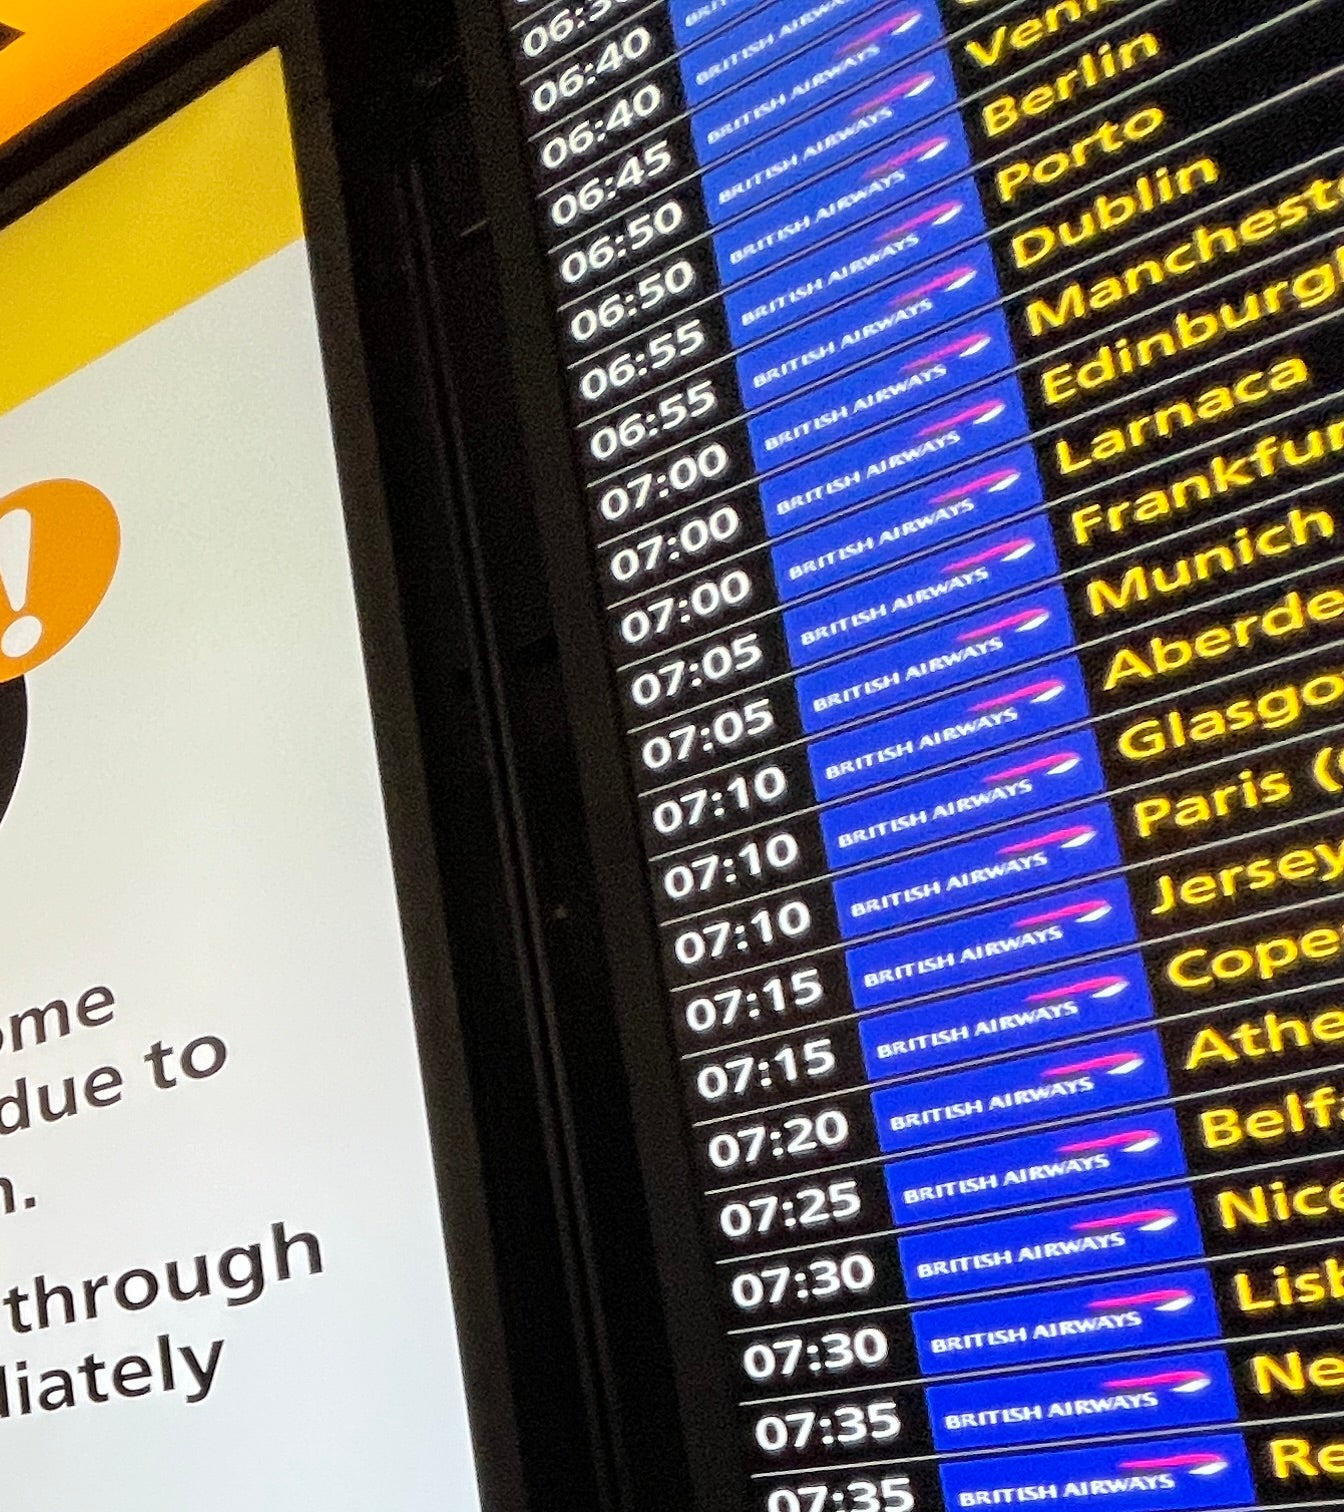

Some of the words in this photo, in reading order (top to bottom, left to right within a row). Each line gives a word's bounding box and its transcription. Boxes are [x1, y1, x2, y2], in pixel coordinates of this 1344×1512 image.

[532, 27, 650, 112] 06:40
[542, 84, 660, 168] 06:40
[697, 34, 774, 84] BRITISH
[552, 140, 671, 225] 06:45
[708, 94, 786, 144] BRITISH
[791, 44, 879, 99] AIRWAYS
[561, 201, 682, 283] 06:50
[719, 154, 797, 204] BRITISH
[804, 107, 892, 159] AIRWAYS
[571, 261, 695, 340] 06:50
[730, 216, 810, 264] BRITISH
[816, 169, 905, 222] AIRWAYS
[983, 33, 1159, 136] Berlin
[580, 319, 704, 400] 06:55
[742, 279, 823, 325] BRITISH
[828, 233, 919, 284] AIRWAYS
[997, 108, 1164, 201] Porto
[591, 381, 717, 460] 06:55
[754, 342, 835, 388] BRITISH
[841, 298, 932, 349] AIRWAYS
[1013, 159, 1218, 268] Dublin
[601, 443, 728, 520] 07:00
[765, 406, 848, 450] BRITISH
[853, 364, 946, 413] AIRWAYS
[1027, 176, 1344, 336] Manchest
[611, 507, 739, 581] 07:00
[777, 471, 860, 514] BRITISH
[867, 431, 960, 478] AIRWAYS
[622, 570, 751, 643] 07:00
[789, 537, 874, 580] BRITISH
[879, 498, 974, 544] AIRWAYS
[1056, 358, 1309, 474] Larnaca
[632, 633, 762, 705] 07:05
[801, 604, 886, 645] BRITISH
[892, 567, 988, 612] AIRWAYS
[643, 699, 773, 768] 07:05
[814, 672, 900, 712] BRITISH
[906, 637, 1003, 680] AIRWAYS
[1088, 509, 1334, 616] Munich
[653, 767, 786, 833] 07:10
[826, 741, 913, 779] BRITISH
[920, 707, 1017, 749] AIRWAYS
[664, 833, 798, 900] 07:10
[839, 811, 927, 847] BRITISH
[933, 779, 1032, 819] AIRWAYS
[675, 902, 810, 964] 07:10
[851, 882, 940, 917] BRITISH
[946, 852, 1047, 891] AIRWAYS
[1133, 769, 1291, 838] Paris
[686, 969, 822, 1031] 07:15
[864, 953, 954, 987] BRITISH
[960, 926, 1063, 963] AIRWAYS
[697, 1039, 835, 1100] 07:15
[877, 1026, 969, 1058] BRITISH
[975, 1001, 1078, 1036] AIRWAYS
[1166, 927, 1344, 987] Cope
[145, 1037, 226, 1088] to
[709, 1111, 848, 1169] 07:20
[890, 1100, 983, 1130] BRITISH
[989, 1077, 1094, 1110] AIRWAYS
[721, 1181, 860, 1236] 07:25
[904, 1175, 998, 1203] BRITISH
[1004, 1154, 1109, 1185] AIRWAYS
[1201, 1087, 1344, 1148] Belf
[4, 1222, 322, 1333] through
[732, 1255, 874, 1307] 07:30
[917, 1251, 1012, 1278] BRITISH
[1018, 1232, 1125, 1261] AIRWAYS
[744, 1328, 888, 1380] 07:30
[931, 1328, 1027, 1353] BRITISH
[1033, 1311, 1142, 1339] AIRWAYS
[756, 1402, 901, 1452] 07:35
[945, 1406, 1042, 1429] BRITISH
[1048, 1392, 1158, 1417] AIRWAYS
[959, 1485, 1057, 1506] BRITISH
[1063, 1474, 1175, 1497] AIRWAYS
